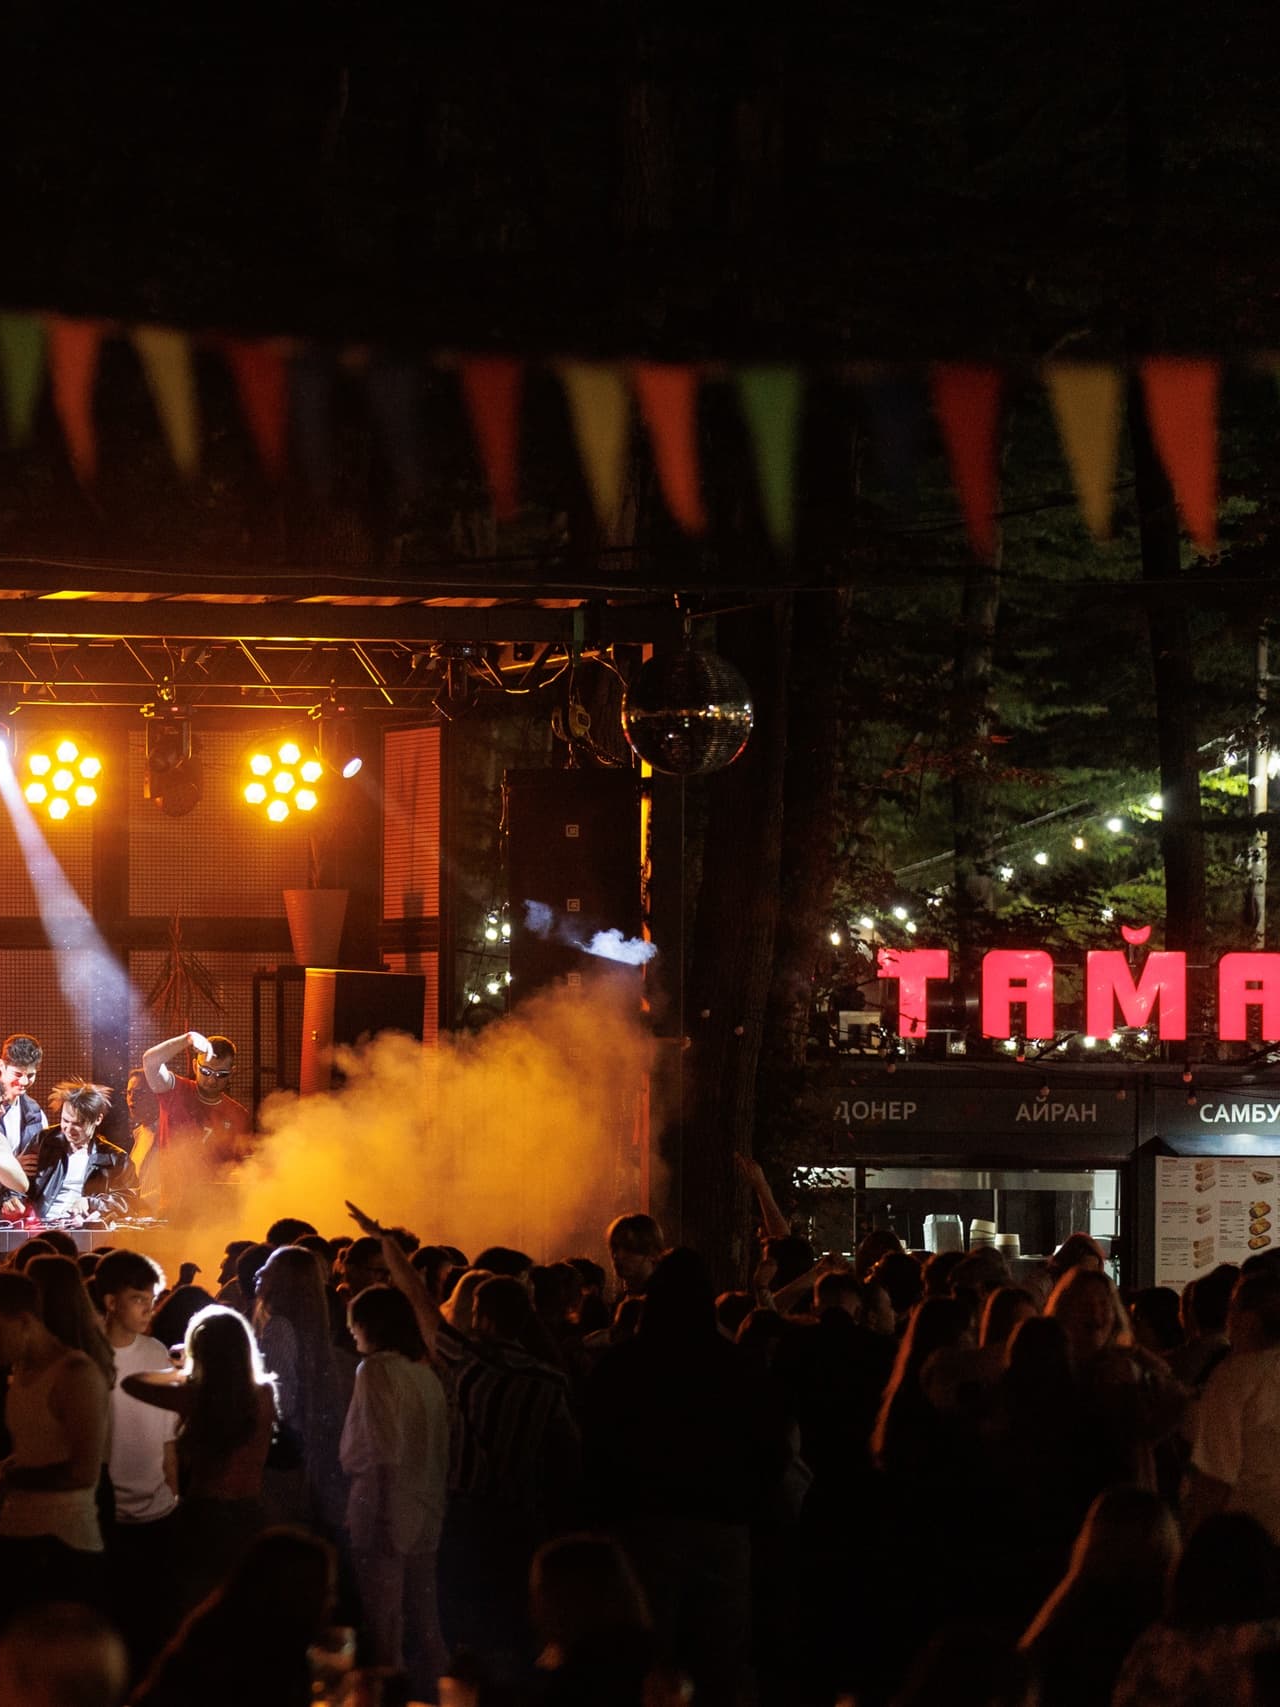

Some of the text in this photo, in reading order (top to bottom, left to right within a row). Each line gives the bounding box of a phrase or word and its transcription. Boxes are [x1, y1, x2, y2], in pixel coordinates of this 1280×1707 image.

[833, 1100, 917, 1125] ДОНЕР
[1015, 1095, 1097, 1122] АЙРАН
[1200, 1103, 1280, 1123] САМБУ
